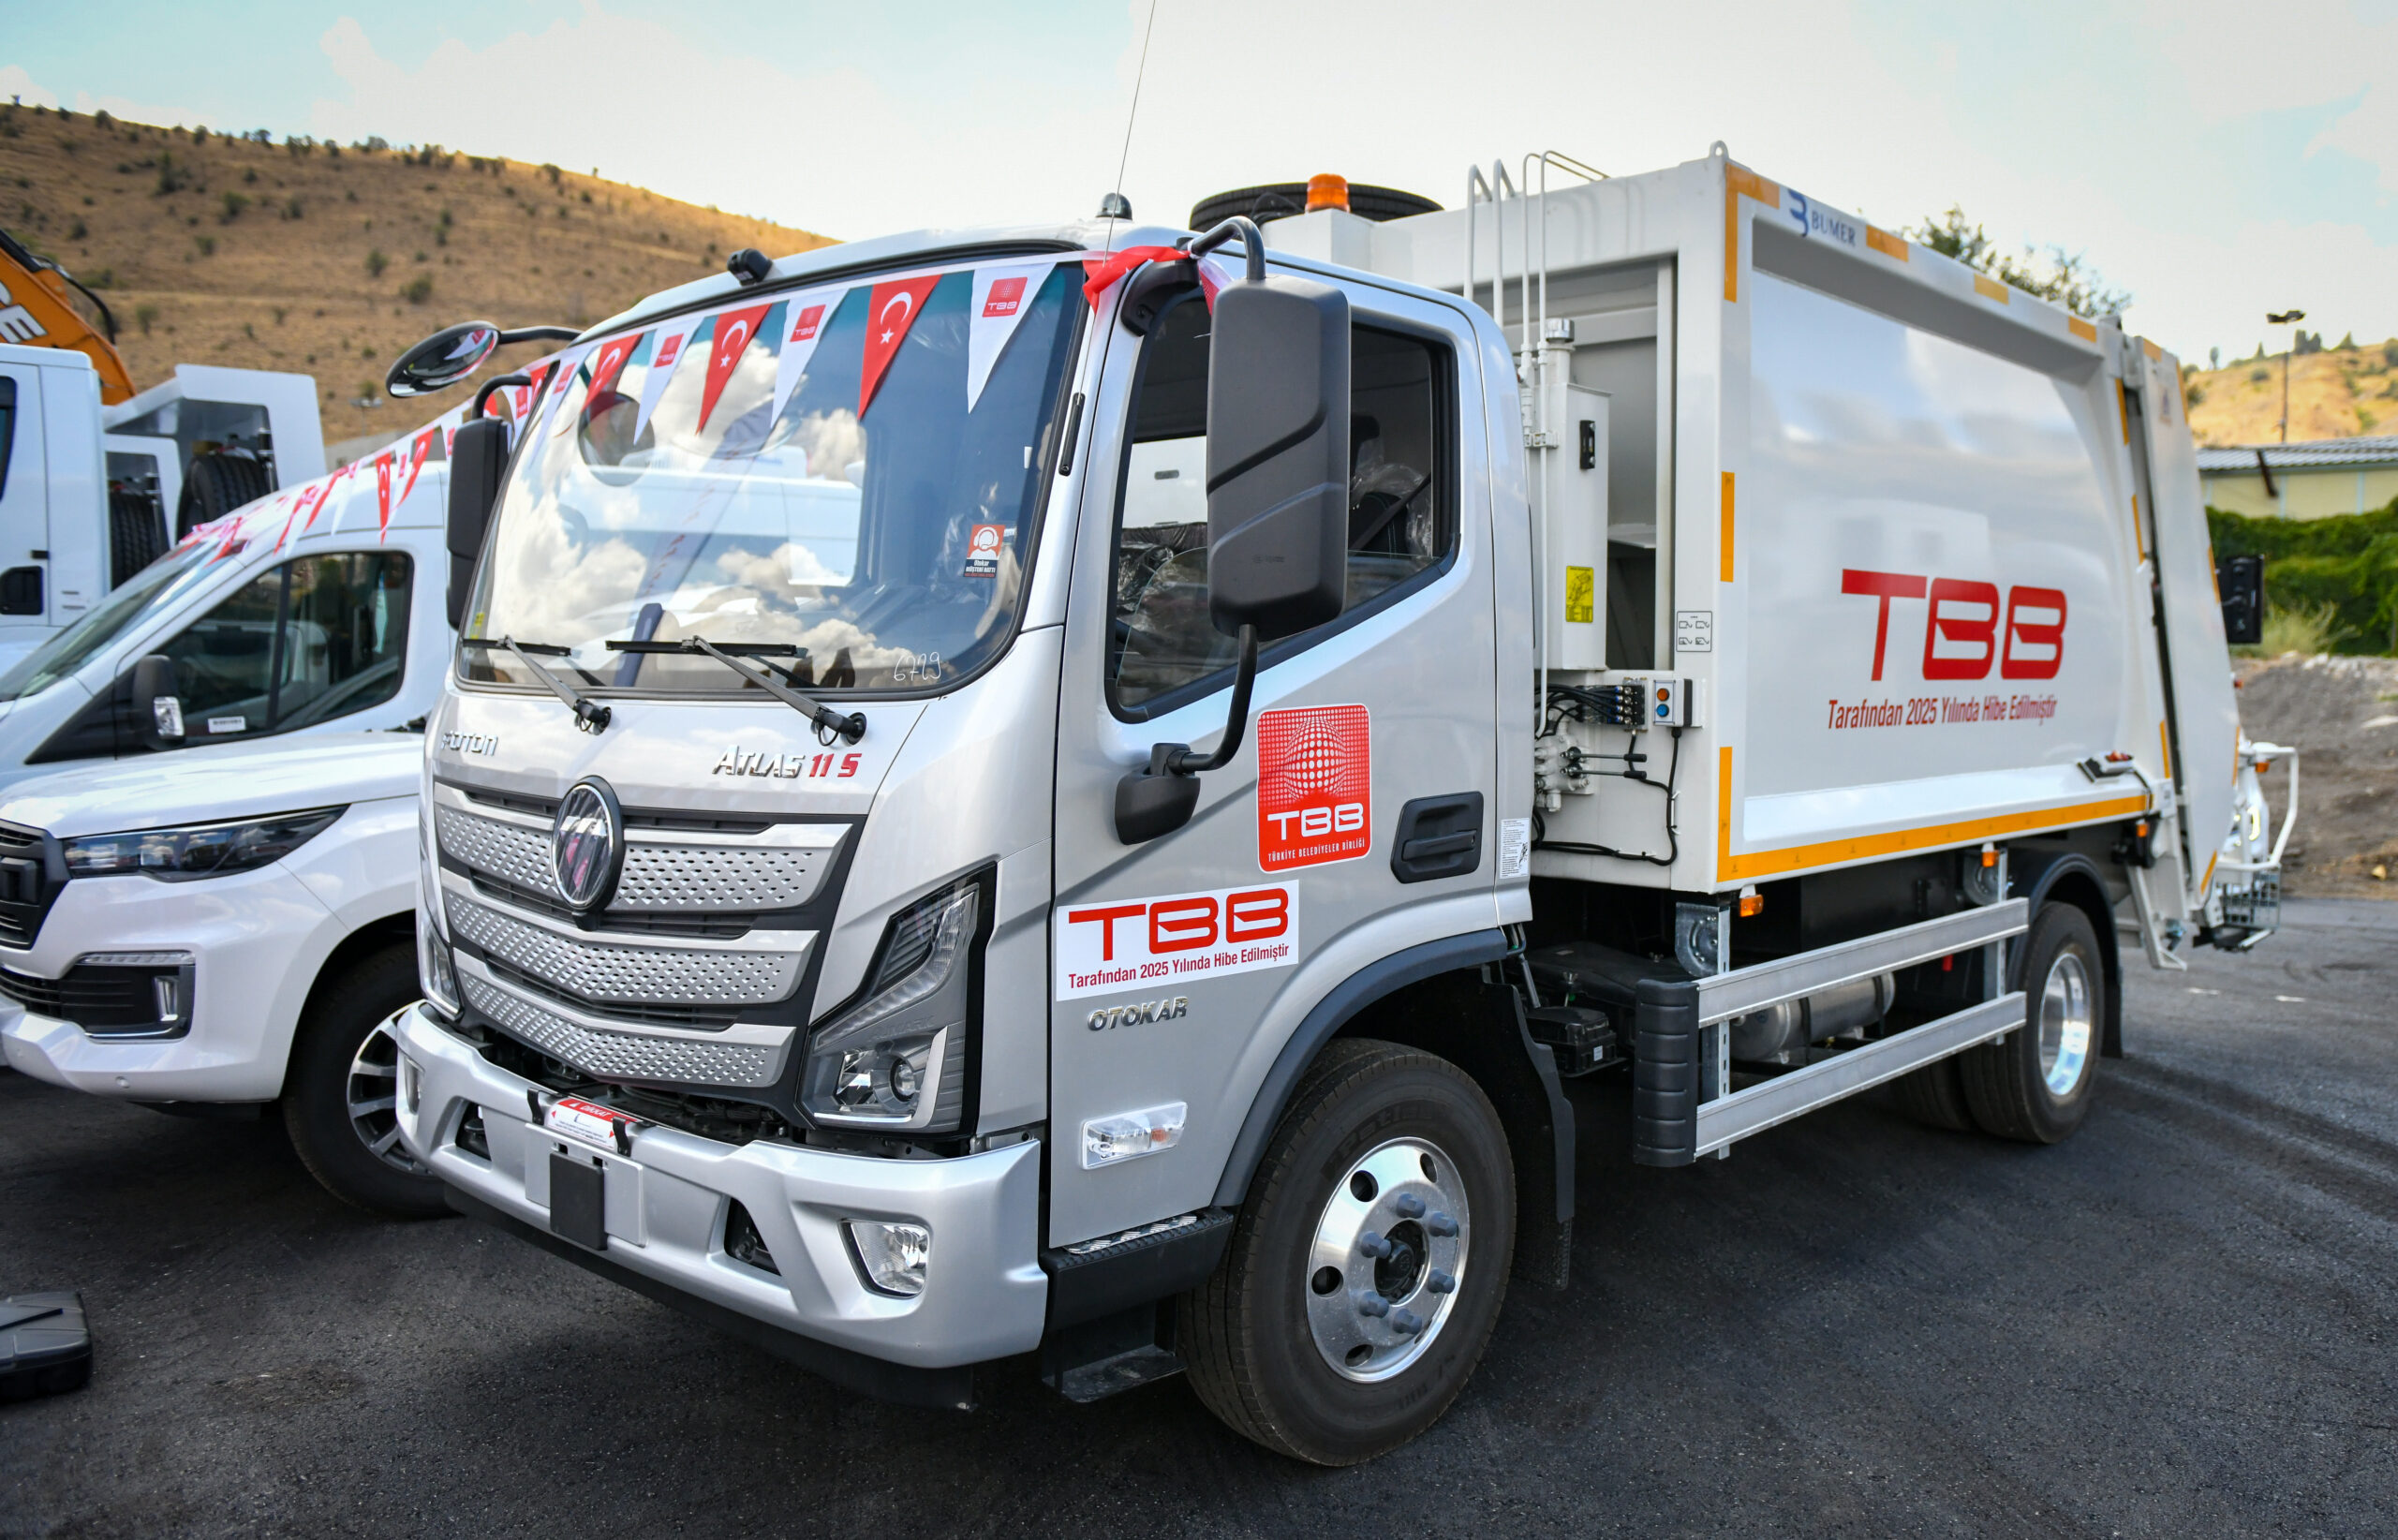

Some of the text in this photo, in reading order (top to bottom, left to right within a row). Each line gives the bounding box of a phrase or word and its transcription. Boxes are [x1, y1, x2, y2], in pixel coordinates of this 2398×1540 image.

[1812, 210, 1856, 247] BUMER
[987, 301, 1018, 311] TBB
[1841, 568, 2068, 681] TBB
[1828, 694, 2058, 729] Tarafından 2025 Yılında Hibe Edilmiştir
[440, 731, 498, 756] FOTON
[1267, 803, 1364, 841] TBB
[1267, 837, 1365, 862] TÜRKİYE BELEDİYELER BİRLİĞİ
[1069, 888, 1289, 961] TBB
[1069, 943, 1290, 989] Tarafından 2025 Yılında Hibe Edilmiştir
[1088, 996, 1189, 1030] OTOKAR
